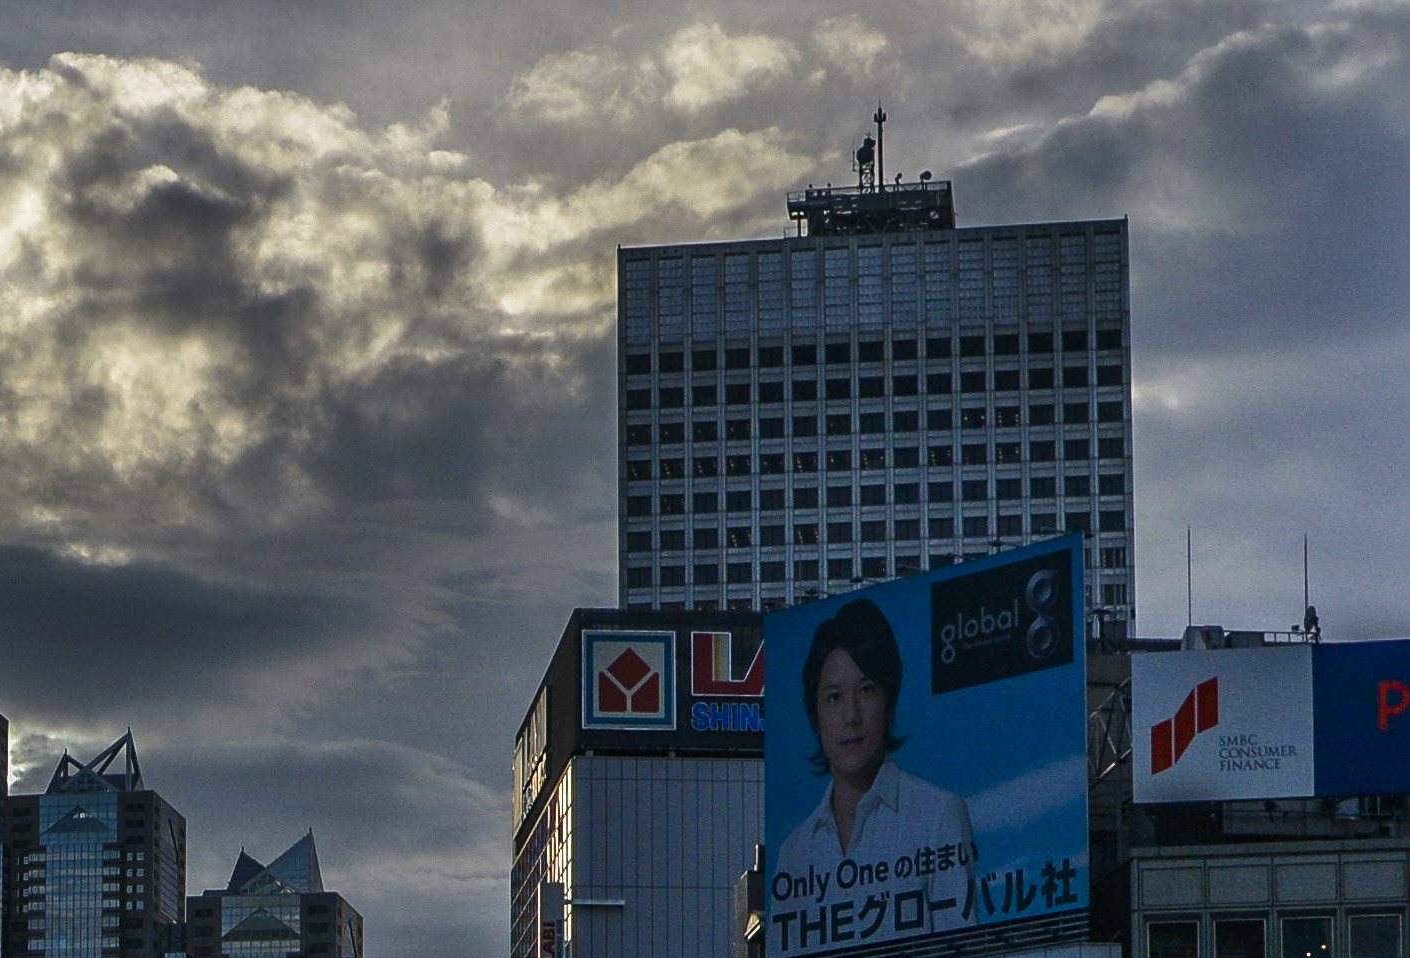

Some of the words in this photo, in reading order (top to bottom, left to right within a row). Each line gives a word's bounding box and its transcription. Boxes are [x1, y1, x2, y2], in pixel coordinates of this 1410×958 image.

[941, 599, 1019, 665] global
[1219, 734, 1258, 746] SMBC
[1219, 745, 1298, 759] CONSUMER
[1219, 758, 1282, 772] FINANCE
[773, 866, 830, 903] Only
[836, 859, 890, 888] One
[772, 858, 1079, 952] THEグローバル社
